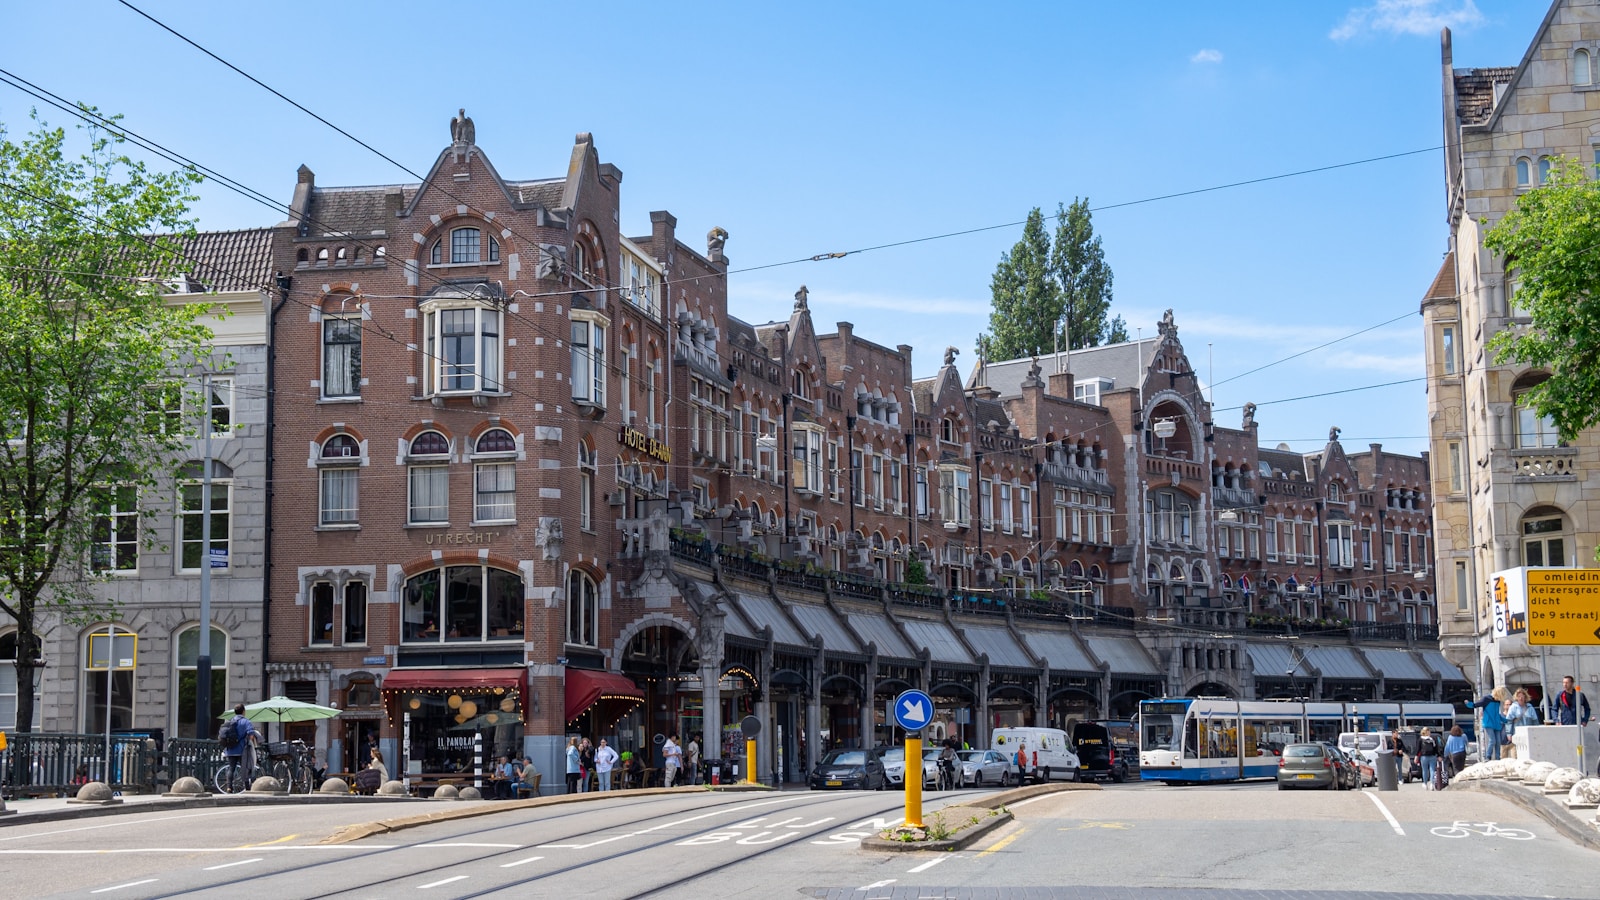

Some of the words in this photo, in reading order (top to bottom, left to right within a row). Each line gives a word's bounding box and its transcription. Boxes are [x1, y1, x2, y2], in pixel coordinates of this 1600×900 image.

[624, 426, 647, 453] HOTEL
[1544, 572, 1599, 581] omleidin
[1531, 586, 1599, 596] Keizersgrac
[1493, 577, 1503, 632] OPEN
[1531, 597, 1560, 605] dicht
[1532, 611, 1545, 619] De
[1549, 611, 1556, 619] 9
[1559, 611, 1598, 621] straatj
[1532, 629, 1555, 638] volg
[675, 831, 872, 845] BUS
